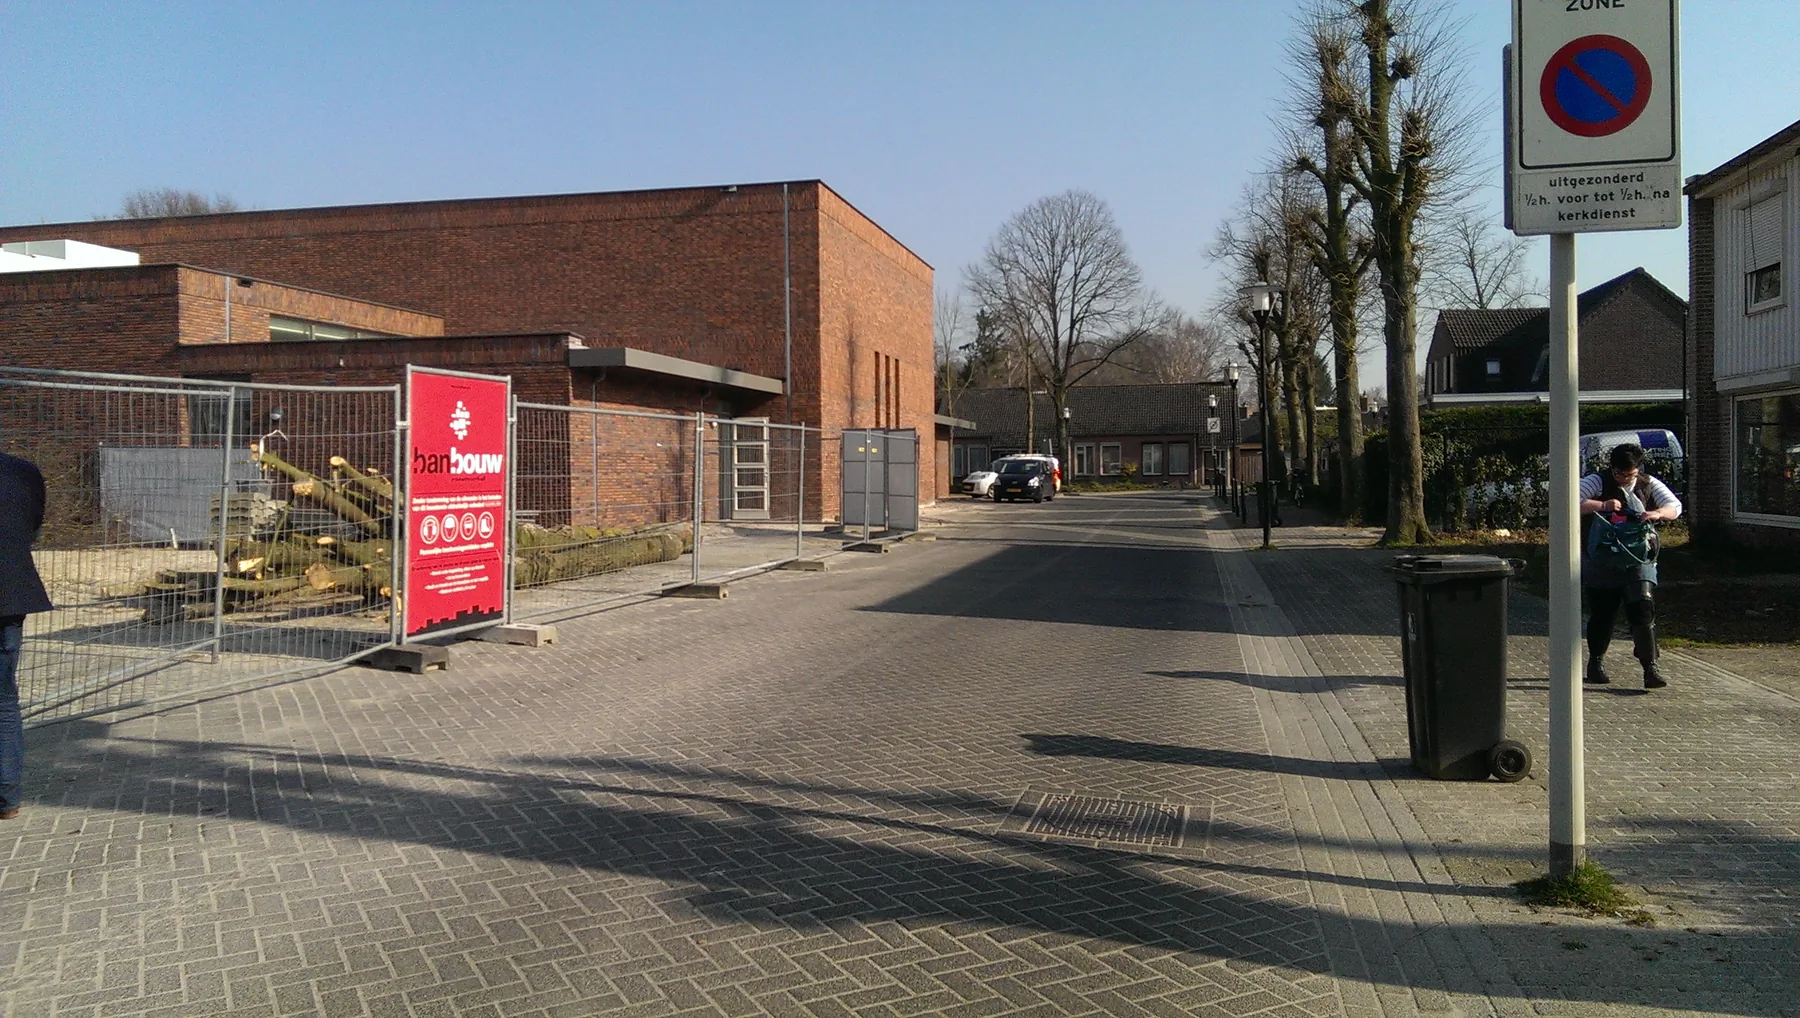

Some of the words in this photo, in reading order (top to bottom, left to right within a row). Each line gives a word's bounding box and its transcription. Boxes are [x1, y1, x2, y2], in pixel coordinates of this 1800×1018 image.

[1549, 172, 1644, 189] uitgezonderd
[1557, 194, 1589, 204] voor
[1594, 191, 1615, 202] tot
[1653, 189, 1670, 199] na
[1558, 207, 1636, 221] kerkdienst
